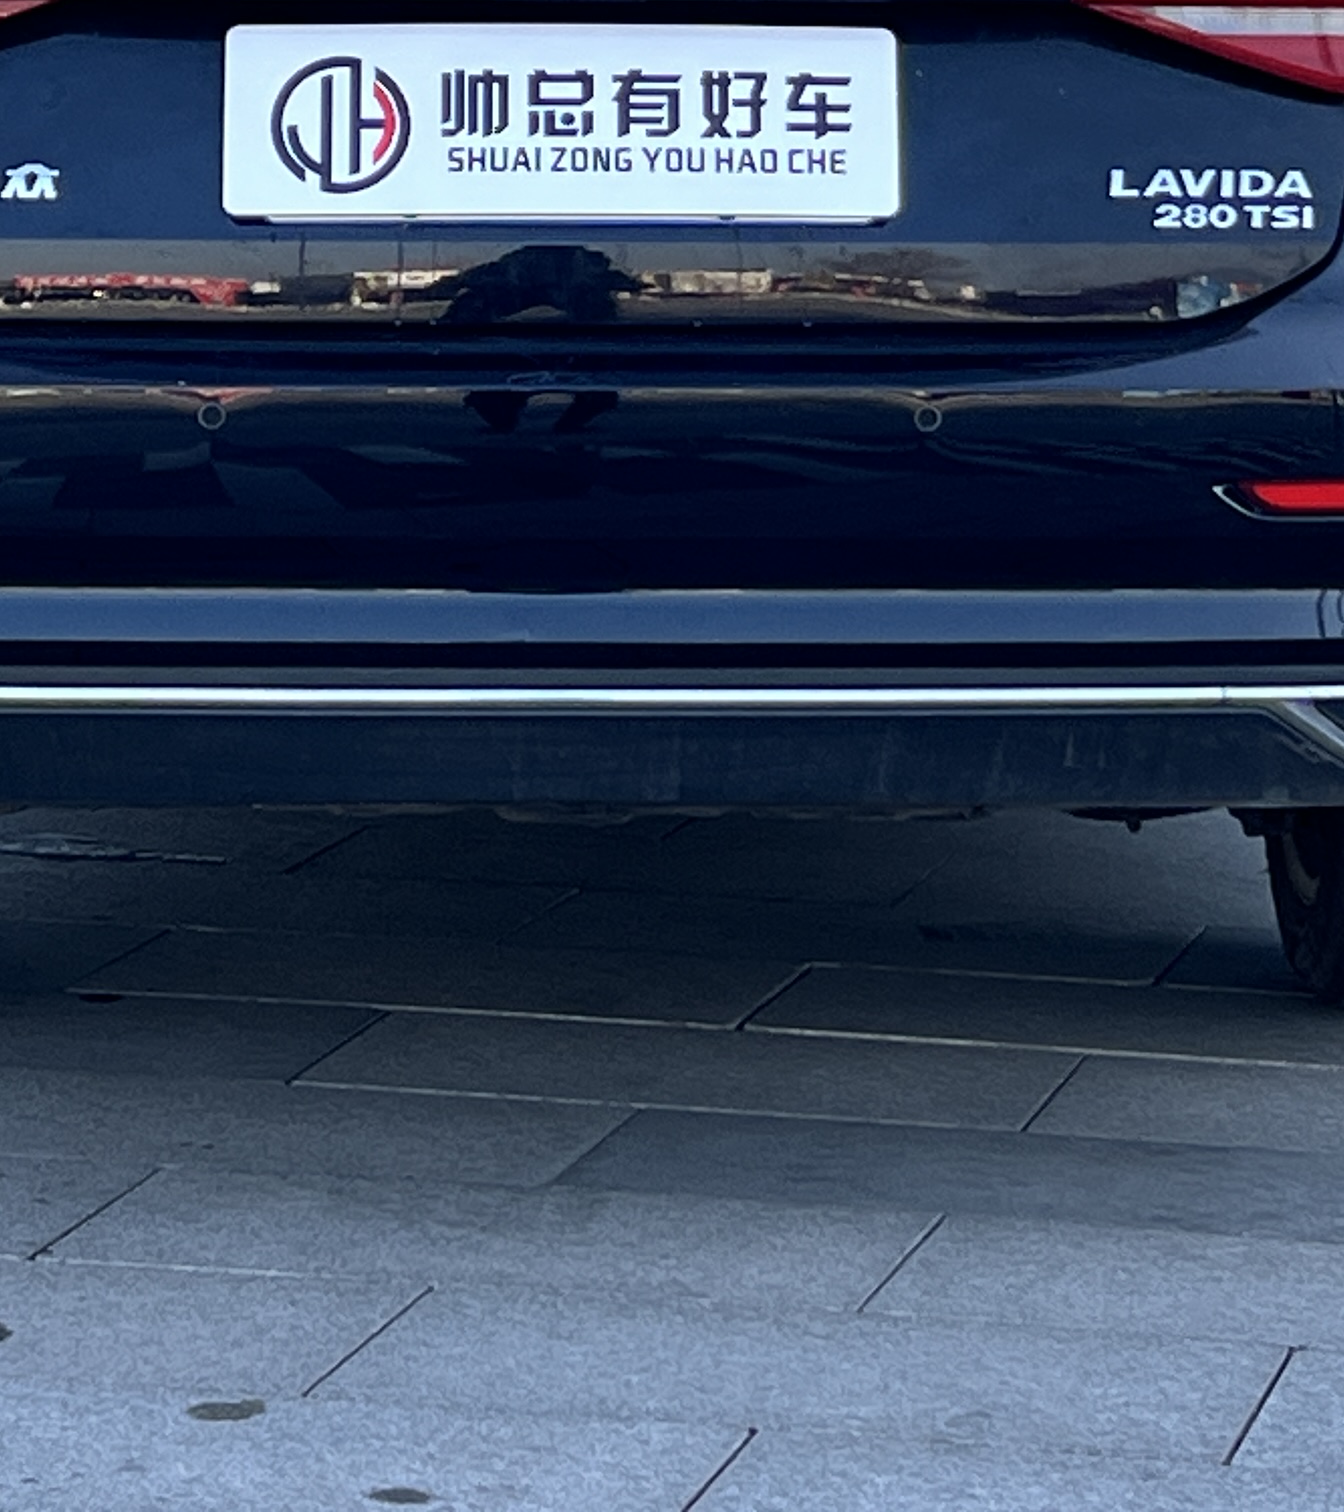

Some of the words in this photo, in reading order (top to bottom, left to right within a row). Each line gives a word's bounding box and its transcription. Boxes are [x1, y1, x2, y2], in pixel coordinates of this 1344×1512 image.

[441, 69, 852, 140] 帅总有好车
[447, 146, 542, 175] SHUAI
[550, 146, 633, 175] ZONG
[641, 146, 706, 175] YOU
[714, 146, 779, 175] HAO
[788, 146, 847, 176] CHE
[1109, 169, 1313, 199] LAVIDA
[1153, 203, 1238, 229] 280
[1242, 204, 1314, 230] TSI
